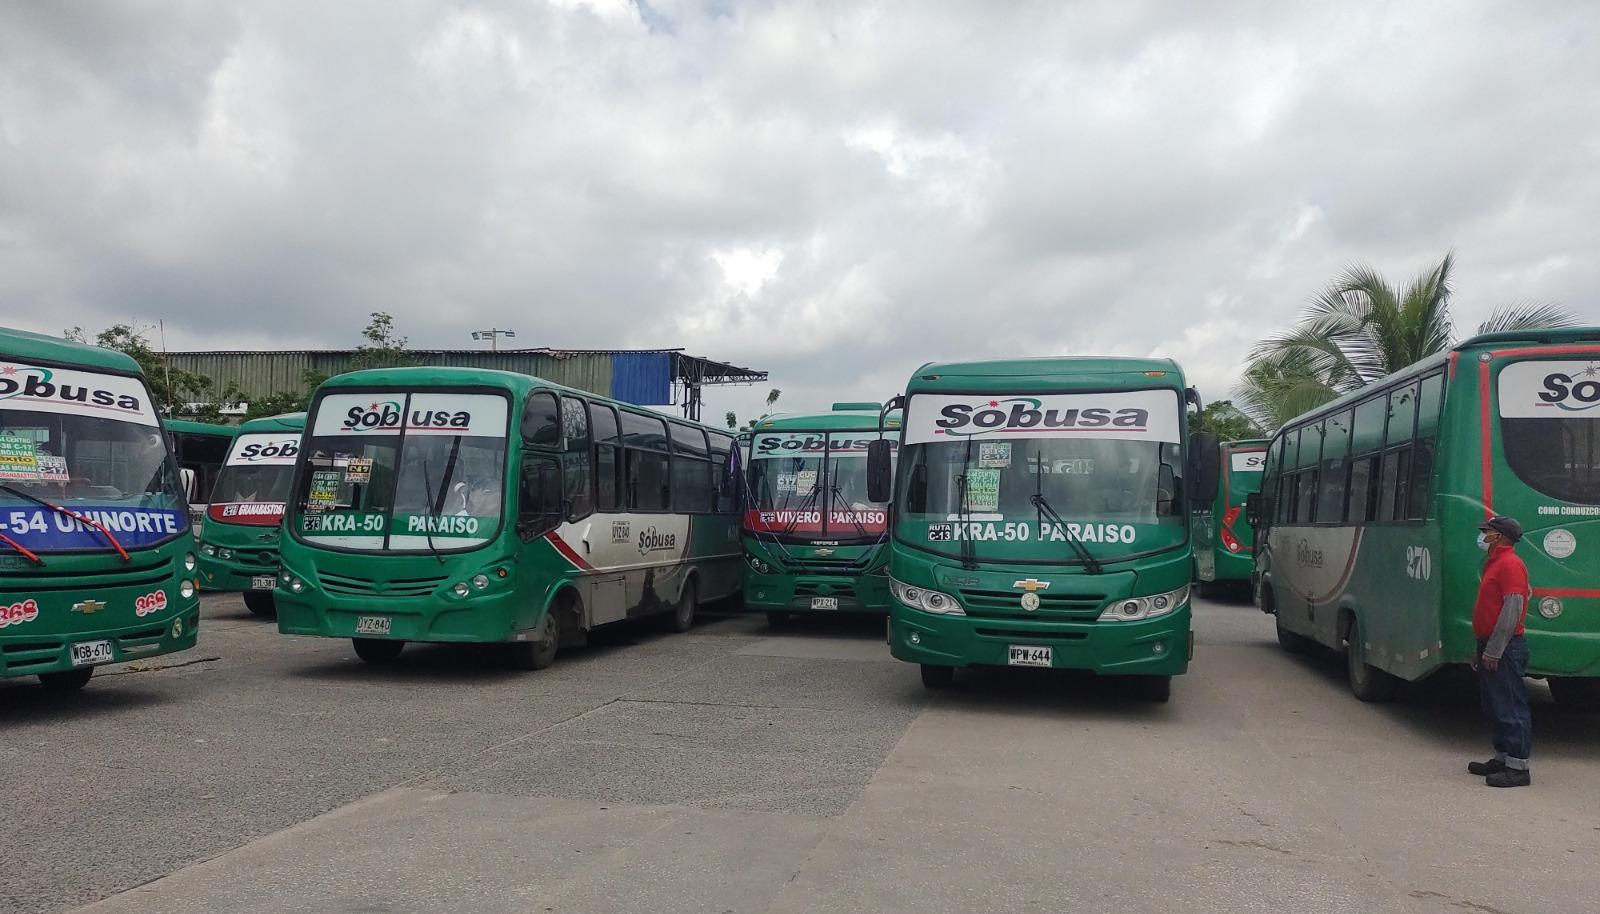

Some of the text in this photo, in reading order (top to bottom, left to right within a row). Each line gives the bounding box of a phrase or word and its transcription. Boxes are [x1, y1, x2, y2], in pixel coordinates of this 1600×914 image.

[935, 403, 1149, 429] Sobusa
[776, 511, 885, 524] VIVERO PARAISO
[1538, 506, 1560, 515] COMO
[53, 510, 178, 534] UNINORTE
[321, 515, 384, 532] KRA-50
[408, 516, 479, 534] PARAISO
[638, 530, 676, 549] Sobusa
[929, 531, 950, 540] C-13
[953, 522, 1136, 544] KRA-50 PARAISO
[1406, 544, 1432, 581] 270
